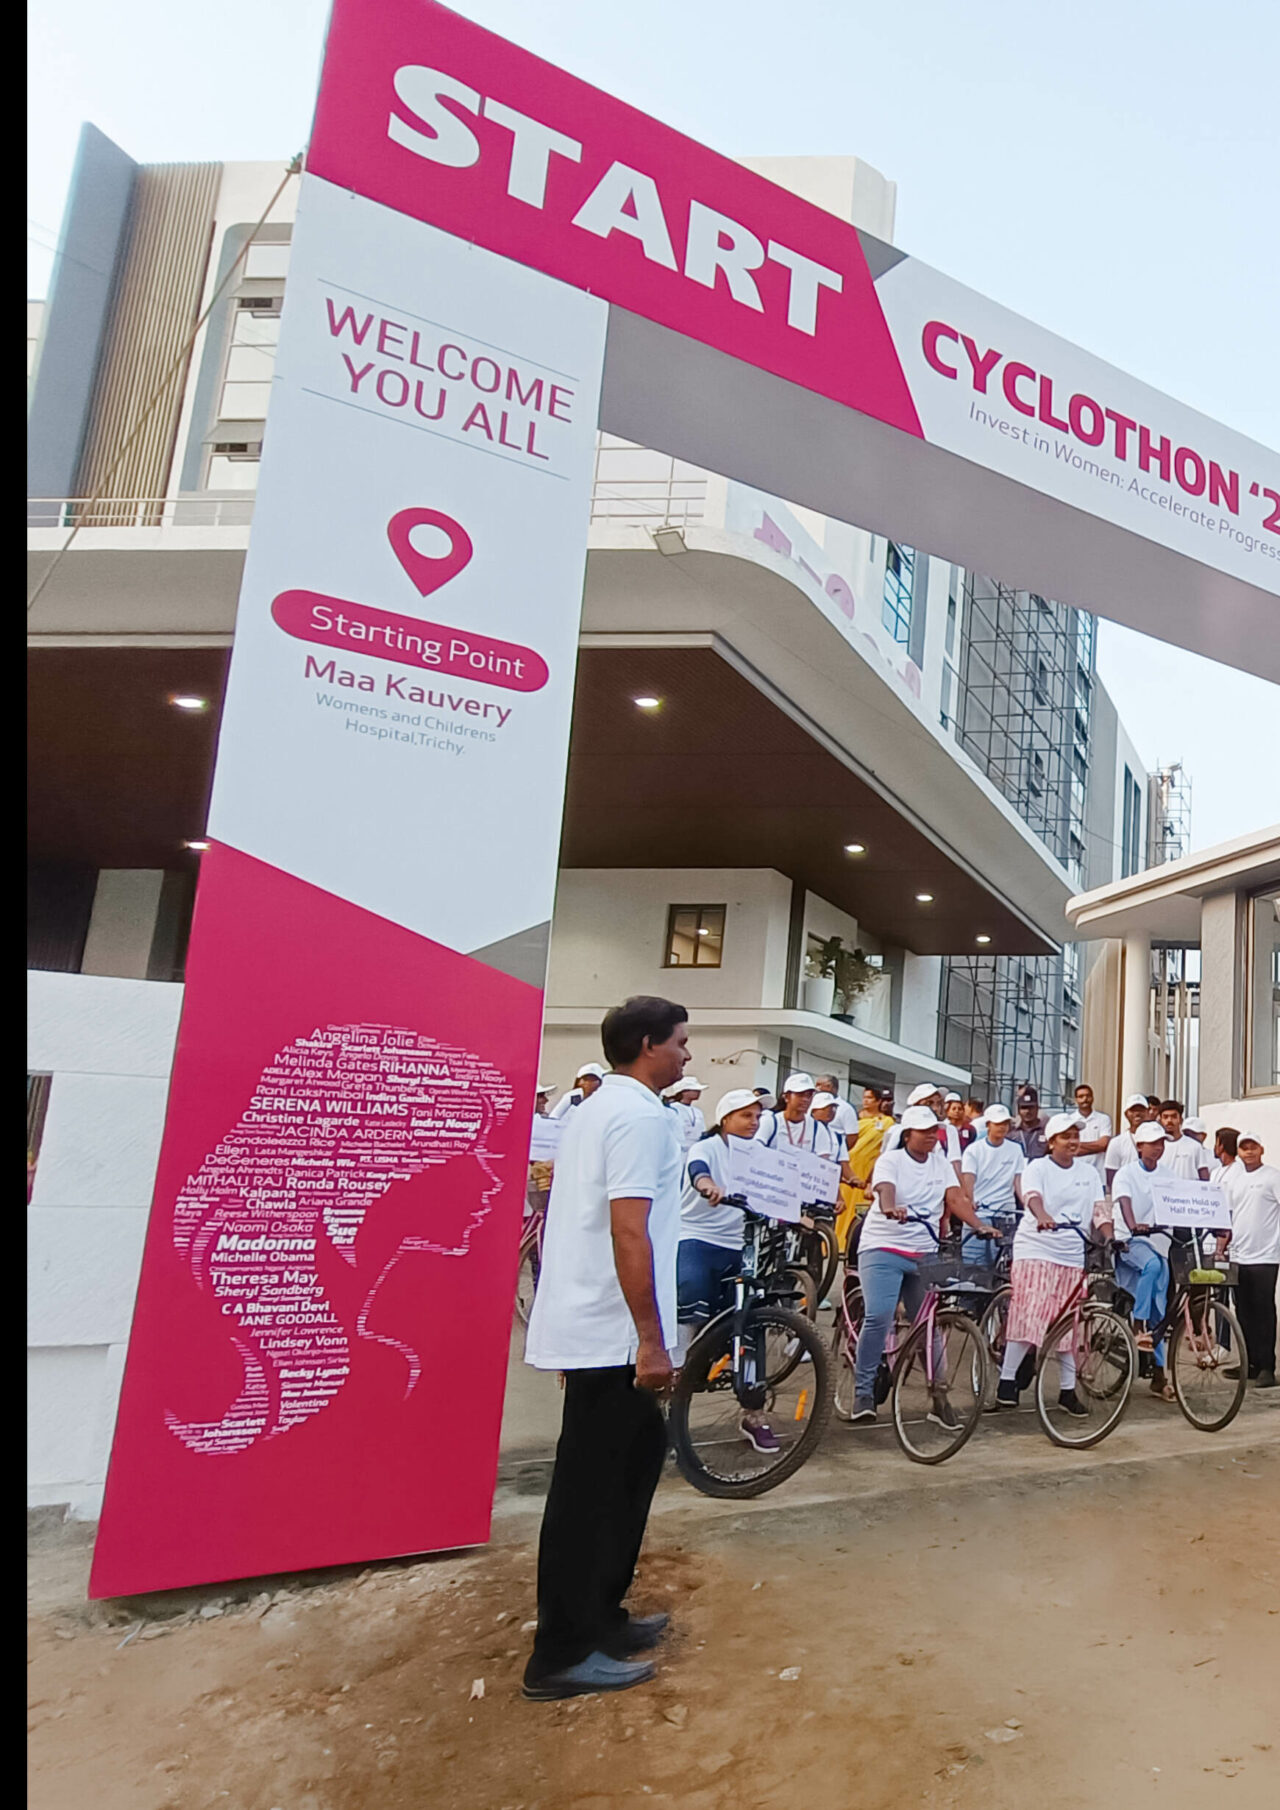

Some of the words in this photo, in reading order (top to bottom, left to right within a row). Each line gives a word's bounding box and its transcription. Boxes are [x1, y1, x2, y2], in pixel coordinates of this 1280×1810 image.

[387, 64, 842, 336] START
[325, 296, 576, 424] WELCOME
[340, 352, 447, 421] YOU
[461, 401, 550, 460] ALL
[921, 320, 1240, 516] CYCLOTHON
[969, 401, 1030, 446] Invest
[1032, 432, 1050, 454] in
[1053, 442, 1126, 490] Women:
[1128, 477, 1216, 531] Accelerate
[309, 604, 443, 665] Starting
[448, 638, 526, 680] Point
[303, 654, 376, 693] Maa
[385, 673, 512, 728] Kauvery
[315, 691, 388, 719] Womens
[390, 710, 421, 727] and
[424, 716, 497, 743] Childrens
[295, 1038, 332, 1048] Shakira
[310, 1028, 378, 1045] Angelina
[380, 1032, 414, 1047] Jolie
[282, 1045, 309, 1055] Alicia
[274, 1053, 333, 1068] Melinda
[336, 1058, 378, 1071] Gates
[379, 1060, 450, 1076] RIHANNA
[263, 1067, 290, 1075] ADELE
[291, 1067, 323, 1079] Alex
[326, 1069, 383, 1083] Morgan
[256, 1084, 287, 1096] Rani
[290, 1086, 364, 1099] Lakshmibai
[365, 1092, 397, 1102] Indira
[398, 1094, 435, 1104] Gandhi
[341, 1080, 373, 1091] Greta
[374, 1082, 424, 1097] Thunberg
[249, 1096, 321, 1111] SERENA
[325, 1100, 409, 1116] WILLIAMS
[242, 1111, 304, 1124] Christine
[307, 1114, 360, 1129] Lagarde
[410, 1117, 444, 1127] Indra
[445, 1119, 482, 1132] Nooyi
[276, 1126, 348, 1139] JACINDA
[352, 1127, 413, 1140] ARDERN
[215, 1144, 249, 1155] Ellen
[309, 1137, 336, 1147] Rice
[453, 1140, 470, 1150] Roy
[205, 1154, 290, 1166] DeGeneres
[199, 1165, 235, 1177] Angela
[236, 1165, 283, 1175] Ahrendts
[285, 1167, 324, 1178] Danica
[326, 1168, 365, 1179] Patrick
[187, 1175, 249, 1186] MITHALI
[252, 1175, 283, 1187] RAJ
[286, 1178, 334, 1190] Ronda
[337, 1178, 391, 1193] Rousey
[239, 1187, 296, 1200] Kalpana
[246, 1199, 297, 1210] Chawla
[298, 1197, 334, 1206] Ariana
[335, 1197, 373, 1207] Grande
[1161, 1195, 1191, 1205] Women
[1210, 1200, 1221, 1208] up
[214, 1209, 249, 1218] Reese
[250, 1209, 319, 1219] Witherspoon
[1169, 1206, 1186, 1214] Half
[1200, 1207, 1216, 1217] Sky
[223, 1222, 268, 1233] Naomi
[270, 1221, 314, 1233] Osaka
[326, 1223, 357, 1236] Sue
[216, 1234, 317, 1251] Madonna
[332, 1236, 355, 1245] Bird
[211, 1251, 267, 1263] Michelle
[269, 1251, 315, 1263] Obama
[210, 1271, 279, 1285] Theresa
[283, 1270, 318, 1286] May
[214, 1285, 259, 1300] Sheryl
[260, 1284, 324, 1297] Sandberg
[222, 1303, 232, 1315] C
[233, 1303, 244, 1314] A
[246, 1302, 299, 1314] Bhavani
[301, 1301, 330, 1312] Devi
[238, 1314, 273, 1327] JANE
[275, 1312, 338, 1325] GOODALL
[250, 1328, 293, 1338] Jennifer
[293, 1326, 344, 1336] Lawrence
[260, 1337, 313, 1349] Lindsey
[315, 1335, 348, 1347] Vonn
[279, 1368, 315, 1379] Becky
[315, 1365, 350, 1378] Lynch
[220, 1417, 267, 1429] Scarlett
[278, 1415, 309, 1426] Taylor
[202, 1427, 262, 1439] Johansson
